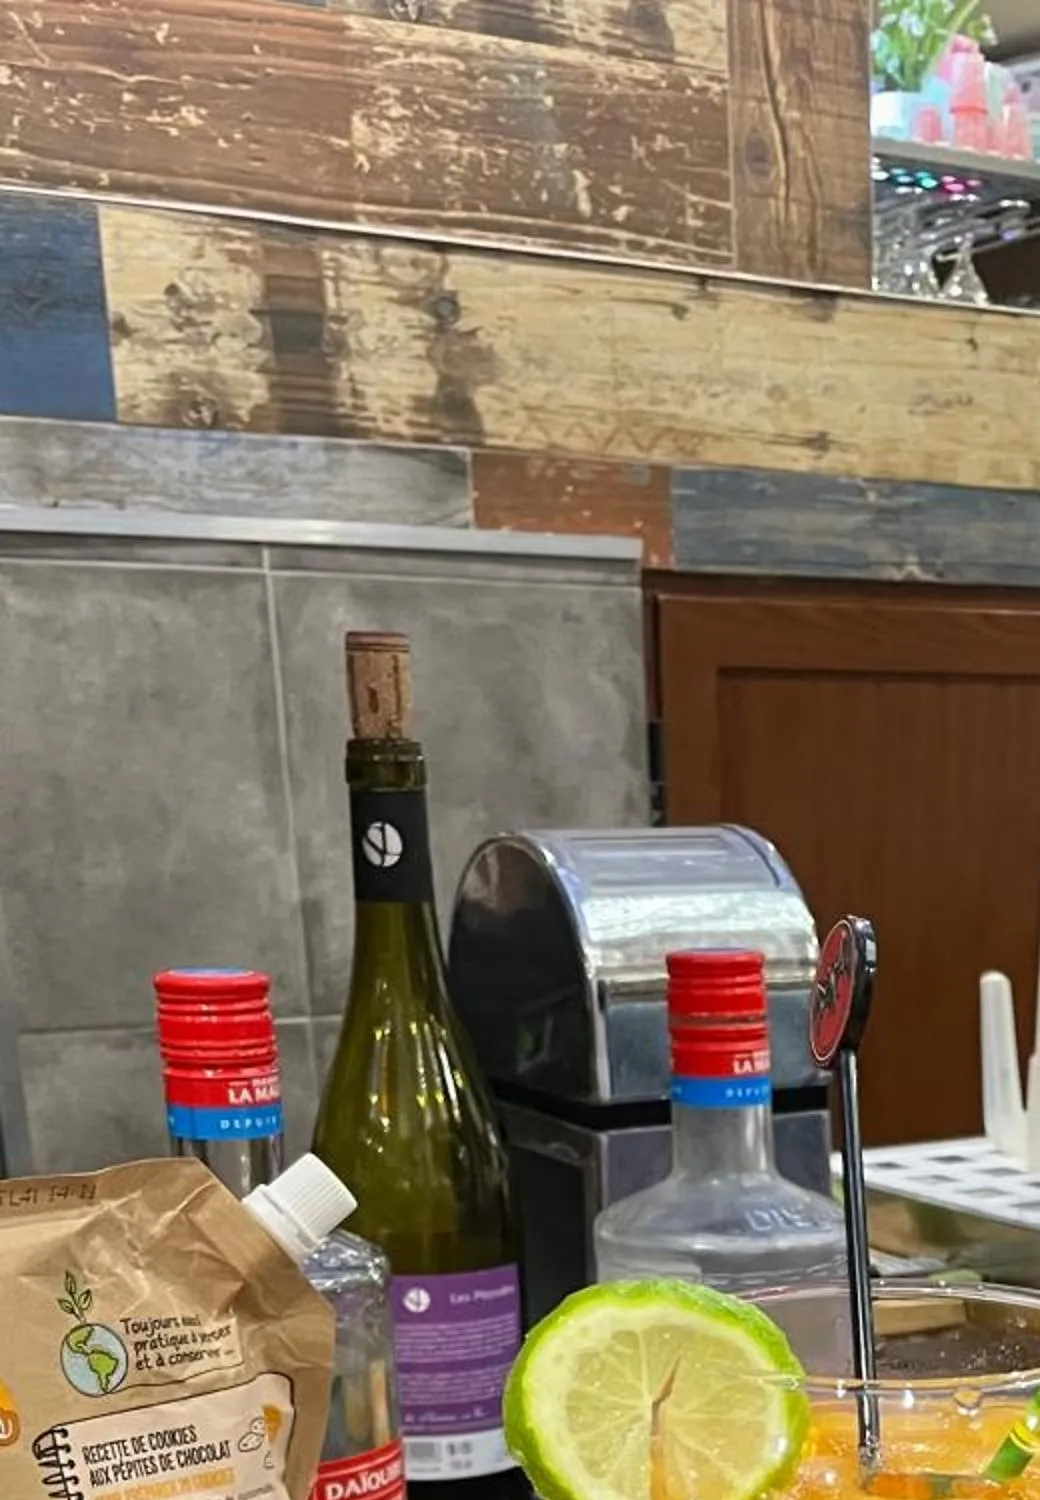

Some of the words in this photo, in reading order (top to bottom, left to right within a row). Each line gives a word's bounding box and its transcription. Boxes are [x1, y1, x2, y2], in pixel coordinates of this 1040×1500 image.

[228, 1088, 253, 1105] LA
[82, 1439, 132, 1465] RECETTE
[131, 1434, 147, 1455] DE
[147, 1424, 198, 1451] COOKIES
[159, 1449, 176, 1473] DE
[175, 1440, 232, 1468] CHOCOLAT
